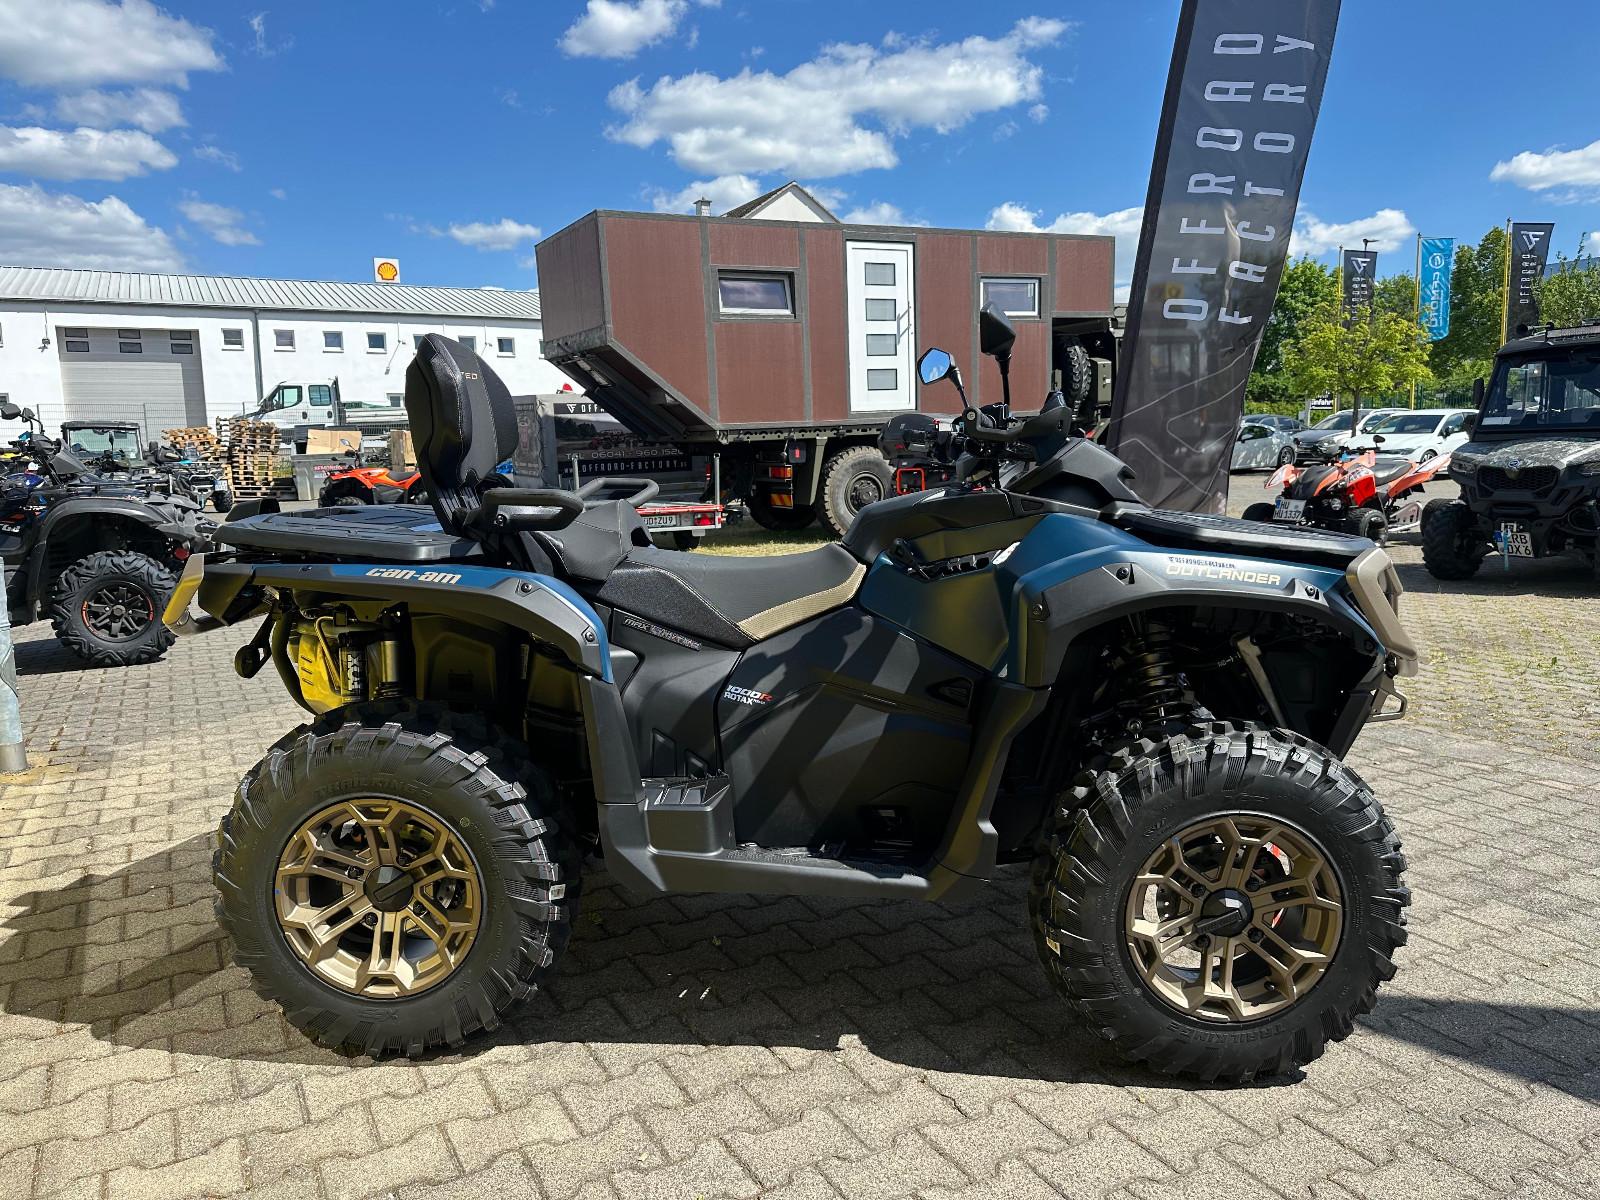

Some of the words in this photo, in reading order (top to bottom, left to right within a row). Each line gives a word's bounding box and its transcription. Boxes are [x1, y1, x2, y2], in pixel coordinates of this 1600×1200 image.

[1163, 33, 1264, 321] OFFROAD
[1218, 34, 1315, 325] FACTORY
[1520, 254, 1530, 304] OFFROAD
[592, 451, 625, 459] 06041
[1280, 501, 1289, 510] HU
[366, 568, 462, 585] can-am
[1166, 564, 1281, 586] OUTLANDER
[623, 618, 650, 631] MAX
[724, 691, 753, 706] ROTAX
[727, 685, 773, 702] 1000R
